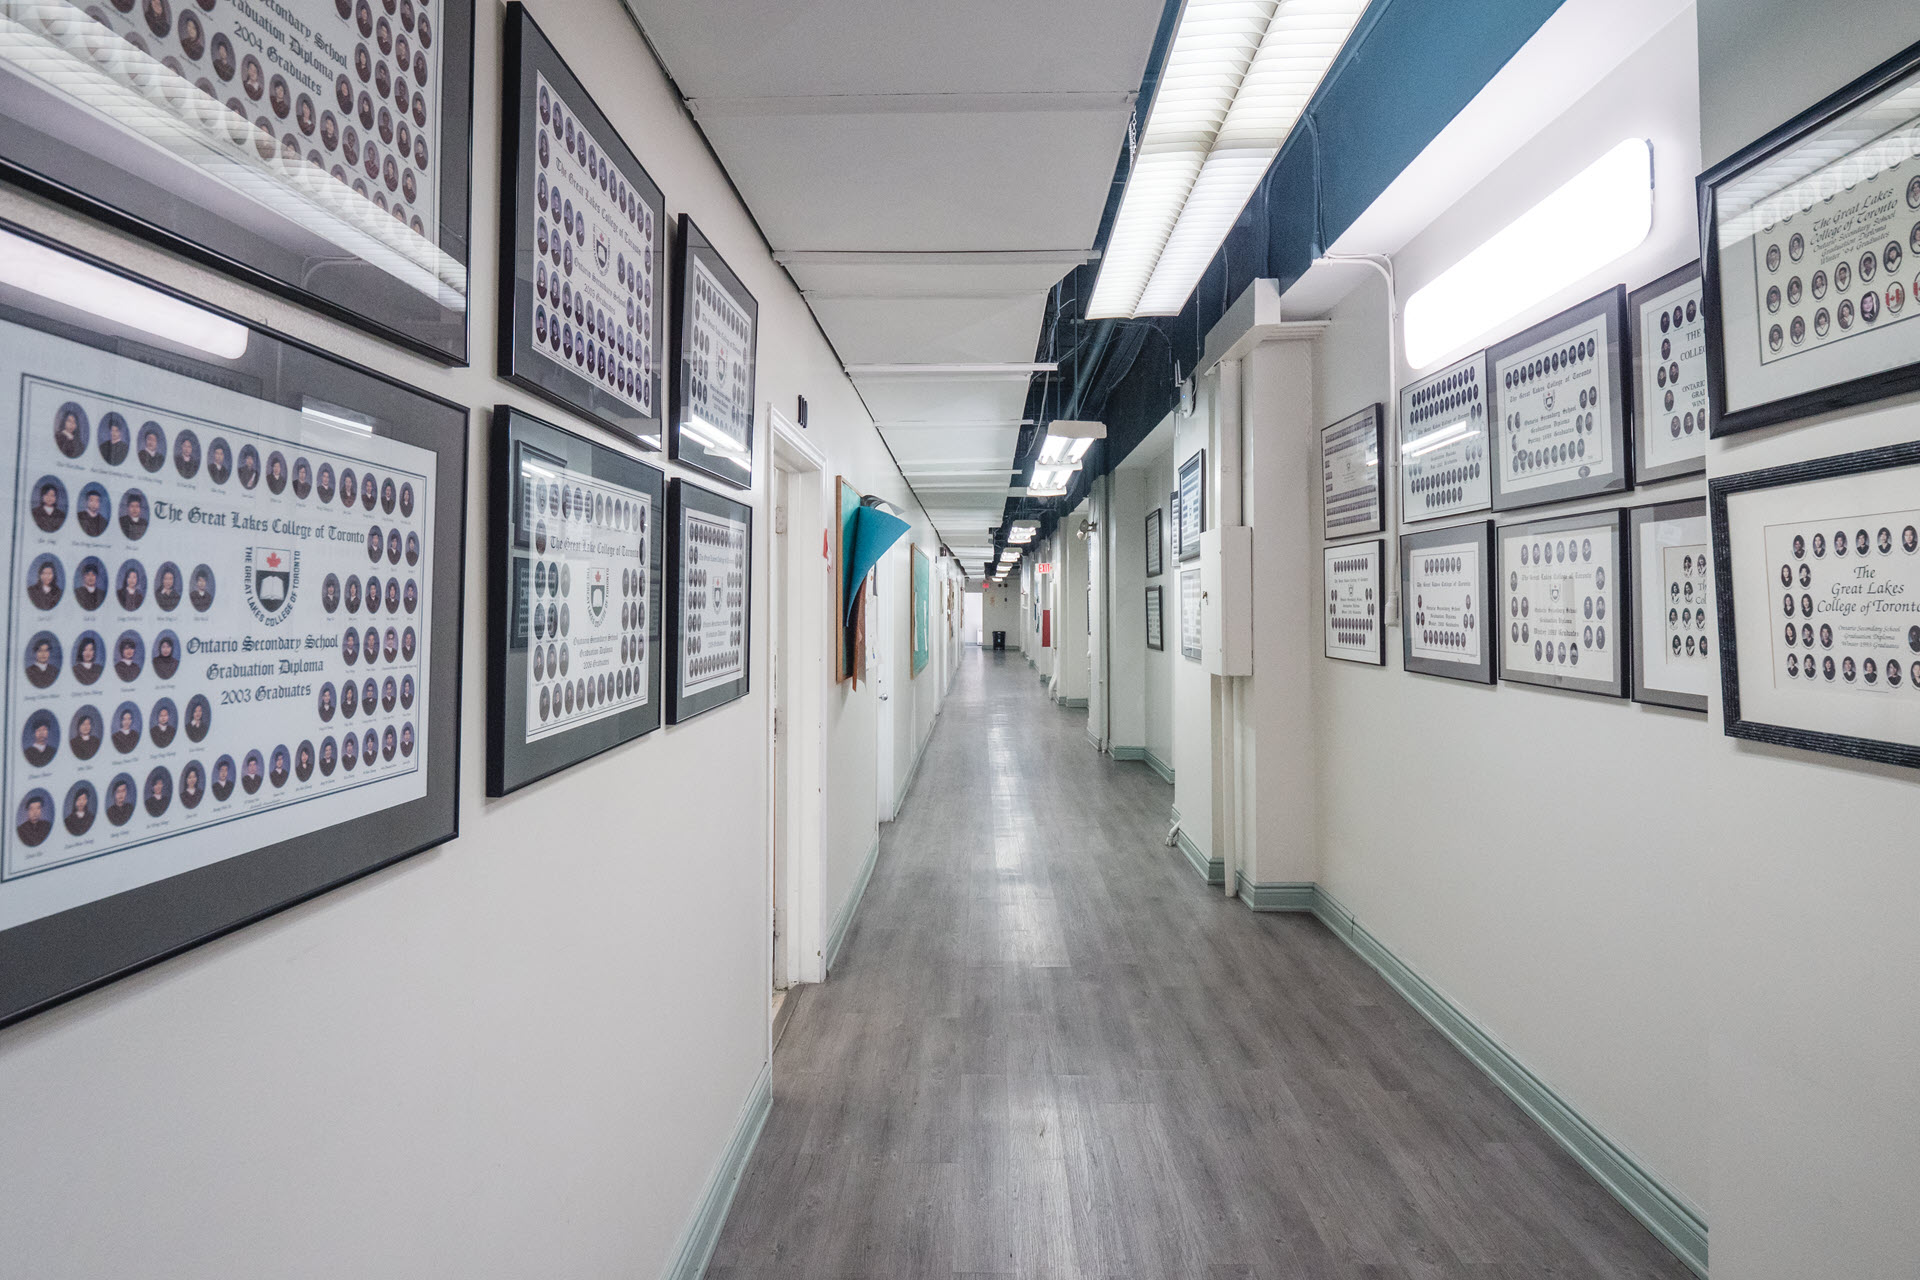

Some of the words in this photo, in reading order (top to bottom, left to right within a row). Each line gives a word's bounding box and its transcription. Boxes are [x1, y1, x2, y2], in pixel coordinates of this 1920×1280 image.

[224, 0, 285, 45] raduation
[289, 35, 334, 81] Diploma
[314, 32, 347, 70] School
[234, 21, 263, 53] 2004
[267, 46, 322, 96] Graduates
[556, 157, 567, 178] The
[569, 173, 584, 196] Great
[1814, 218, 1832, 231] The
[1833, 203, 1860, 224] Great
[1861, 188, 1894, 210] Lakes
[1810, 225, 1843, 246] College
[1844, 217, 1855, 232] of
[1857, 200, 1898, 224] Toronto
[1814, 239, 1837, 253] Ontario
[1839, 224, 1872, 242] Secondary
[1873, 210, 1896, 226] School
[1822, 238, 1856, 257] Graduation
[1859, 225, 1887, 241] Diploma
[1687, 329, 1701, 341] THE
[154, 500, 183, 524] The
[188, 506, 225, 527] Great
[231, 511, 268, 532] Lakes
[271, 518, 312, 540] College
[314, 525, 324, 539] of
[328, 525, 365, 544] Toronto
[244, 546, 253, 563] THE
[551, 536, 563, 551] The
[564, 538, 581, 551] Great
[597, 542, 615, 558] College
[616, 546, 621, 556] of
[622, 546, 639, 558] Toronto
[244, 565, 253, 595] GREAT
[292, 550, 301, 589] TORONTO
[1039, 564, 1050, 573] EXIT
[1854, 565, 1876, 579] The
[289, 591, 298, 603] OF
[1832, 583, 1863, 599] Great
[1867, 580, 1905, 596] Lakes
[246, 596, 265, 623] LAKES
[264, 603, 294, 627] COLLEGE
[1817, 599, 1857, 616] College
[1860, 601, 1872, 616] of
[186, 637, 238, 655] Ontario
[241, 635, 301, 653] Secondary
[304, 634, 339, 651] School
[206, 663, 274, 680] Graduation
[278, 658, 324, 676] Diploma
[220, 688, 251, 705] 2003
[255, 683, 312, 702] Graduates
